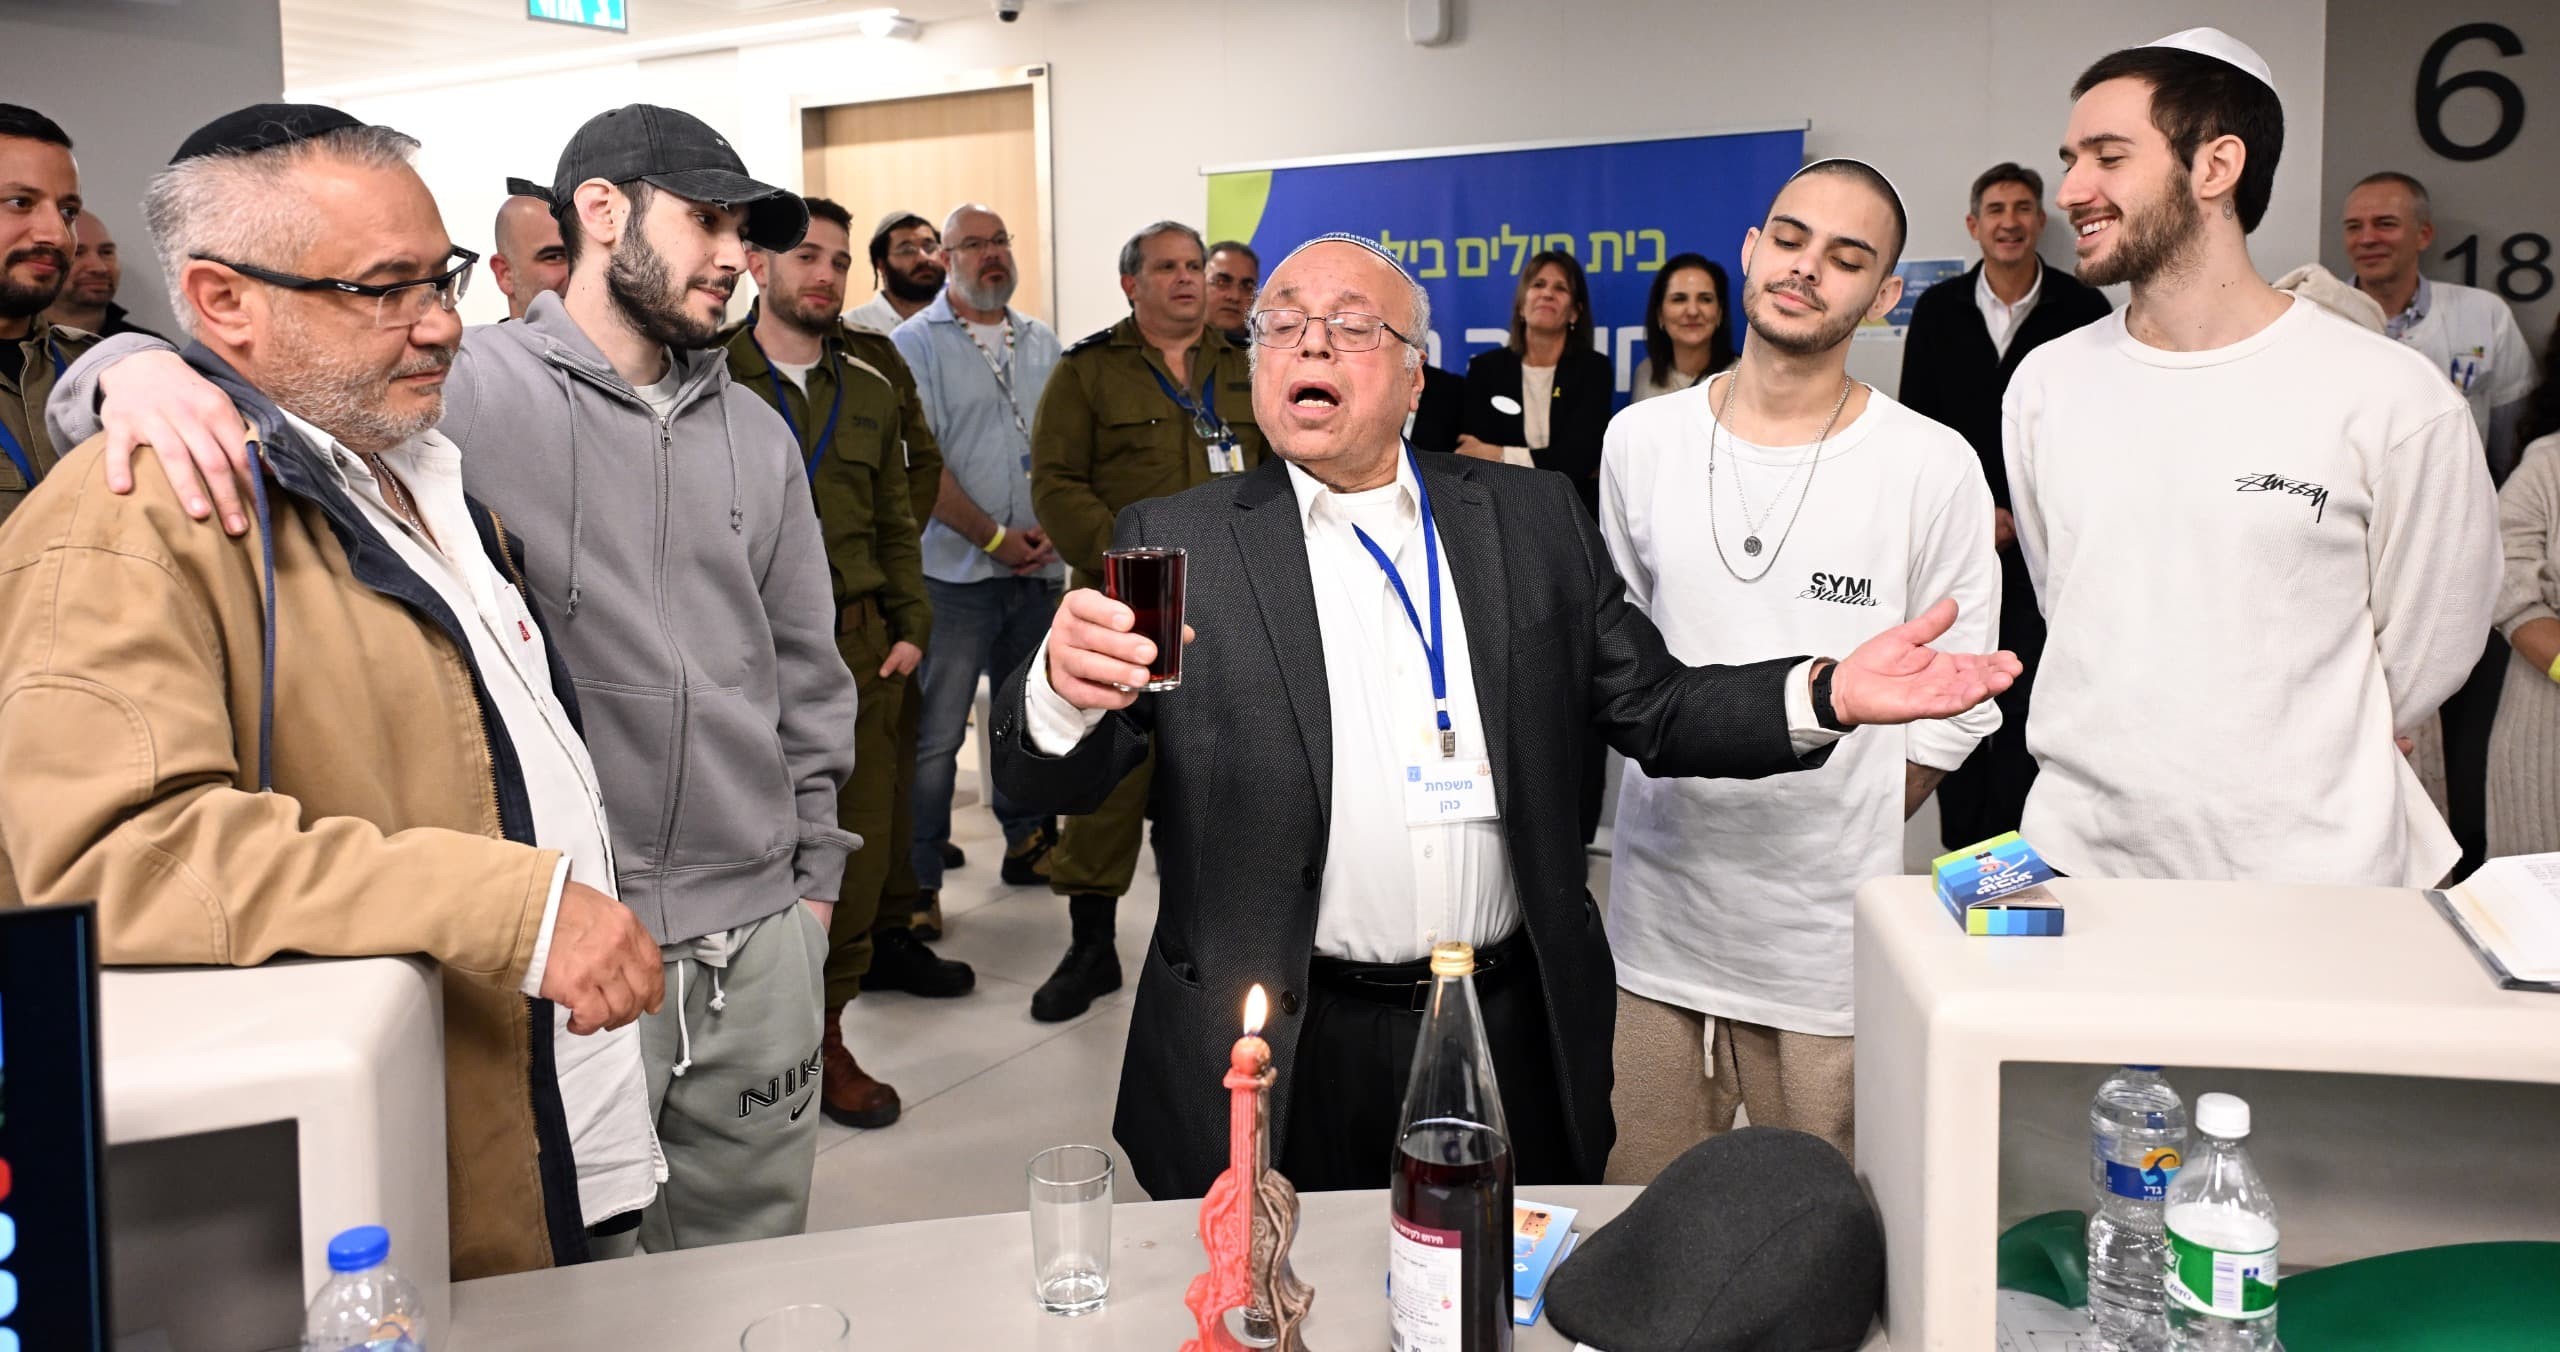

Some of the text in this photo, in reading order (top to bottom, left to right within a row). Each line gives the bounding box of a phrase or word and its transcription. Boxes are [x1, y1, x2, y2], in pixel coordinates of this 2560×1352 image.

[2415, 22, 2525, 162] 6
[1586, 230, 1666, 273] בית
[2443, 232, 2554, 302] 18
[1810, 572, 1872, 598] SYMI
[1424, 779, 1473, 792] משפחת
[1440, 800, 1461, 814] כהן
